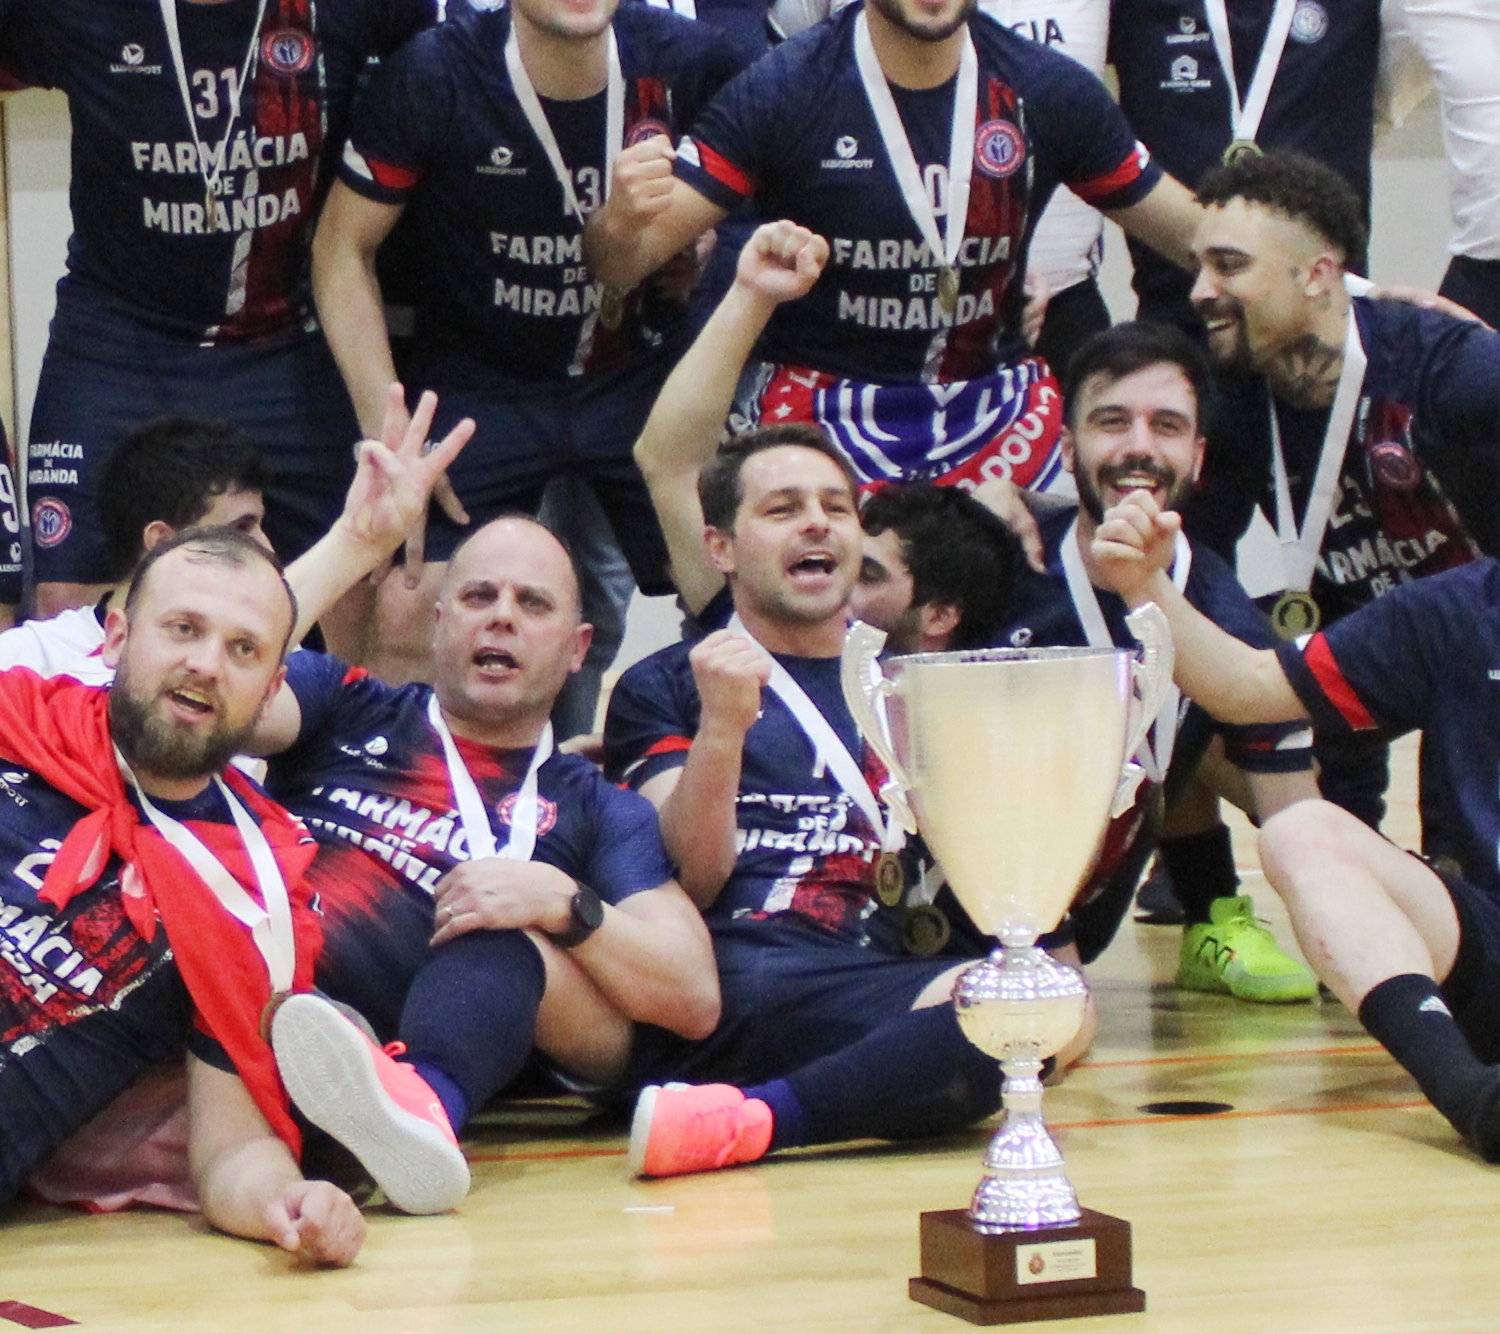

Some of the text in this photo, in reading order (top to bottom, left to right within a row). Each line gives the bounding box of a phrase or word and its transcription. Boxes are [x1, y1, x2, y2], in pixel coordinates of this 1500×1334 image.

[192, 67, 242, 119] 31
[131, 130, 309, 174] FARMÁCIA
[143, 187, 301, 234] MIRANDA
[490, 231, 582, 265] FARM
[564, 267, 588, 284] DE
[909, 273, 936, 293] DE
[494, 278, 605, 317] MIRAN
